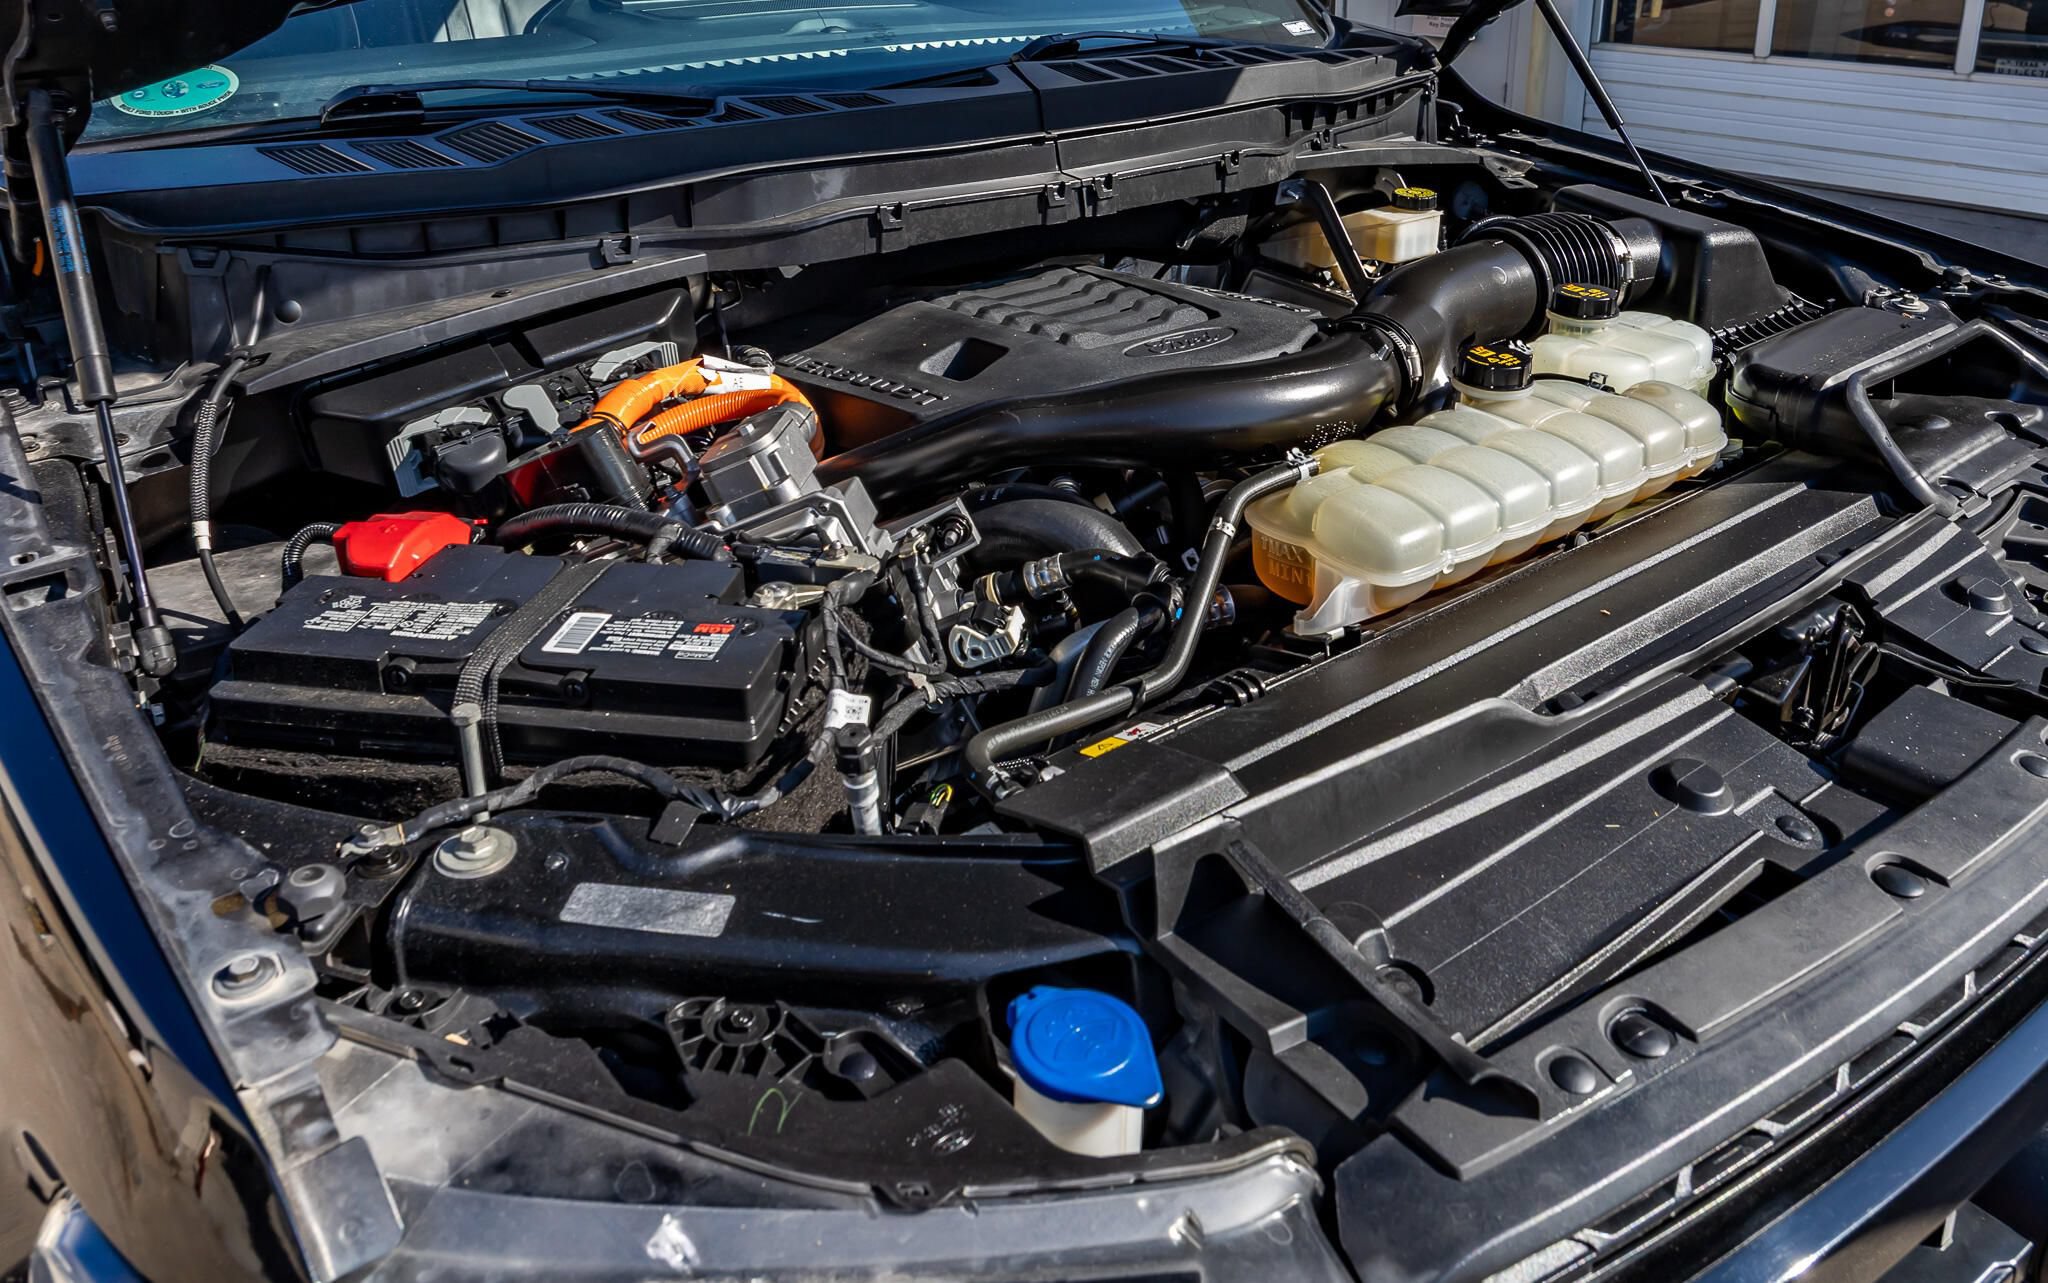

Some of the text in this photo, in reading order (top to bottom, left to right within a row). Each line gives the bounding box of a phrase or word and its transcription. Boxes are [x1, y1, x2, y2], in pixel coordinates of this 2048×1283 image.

[180, 106, 198, 115] WITH
[1144, 331, 1221, 354] Ford
[1269, 558, 1303, 585] MIN
[693, 624, 736, 634] AGM
